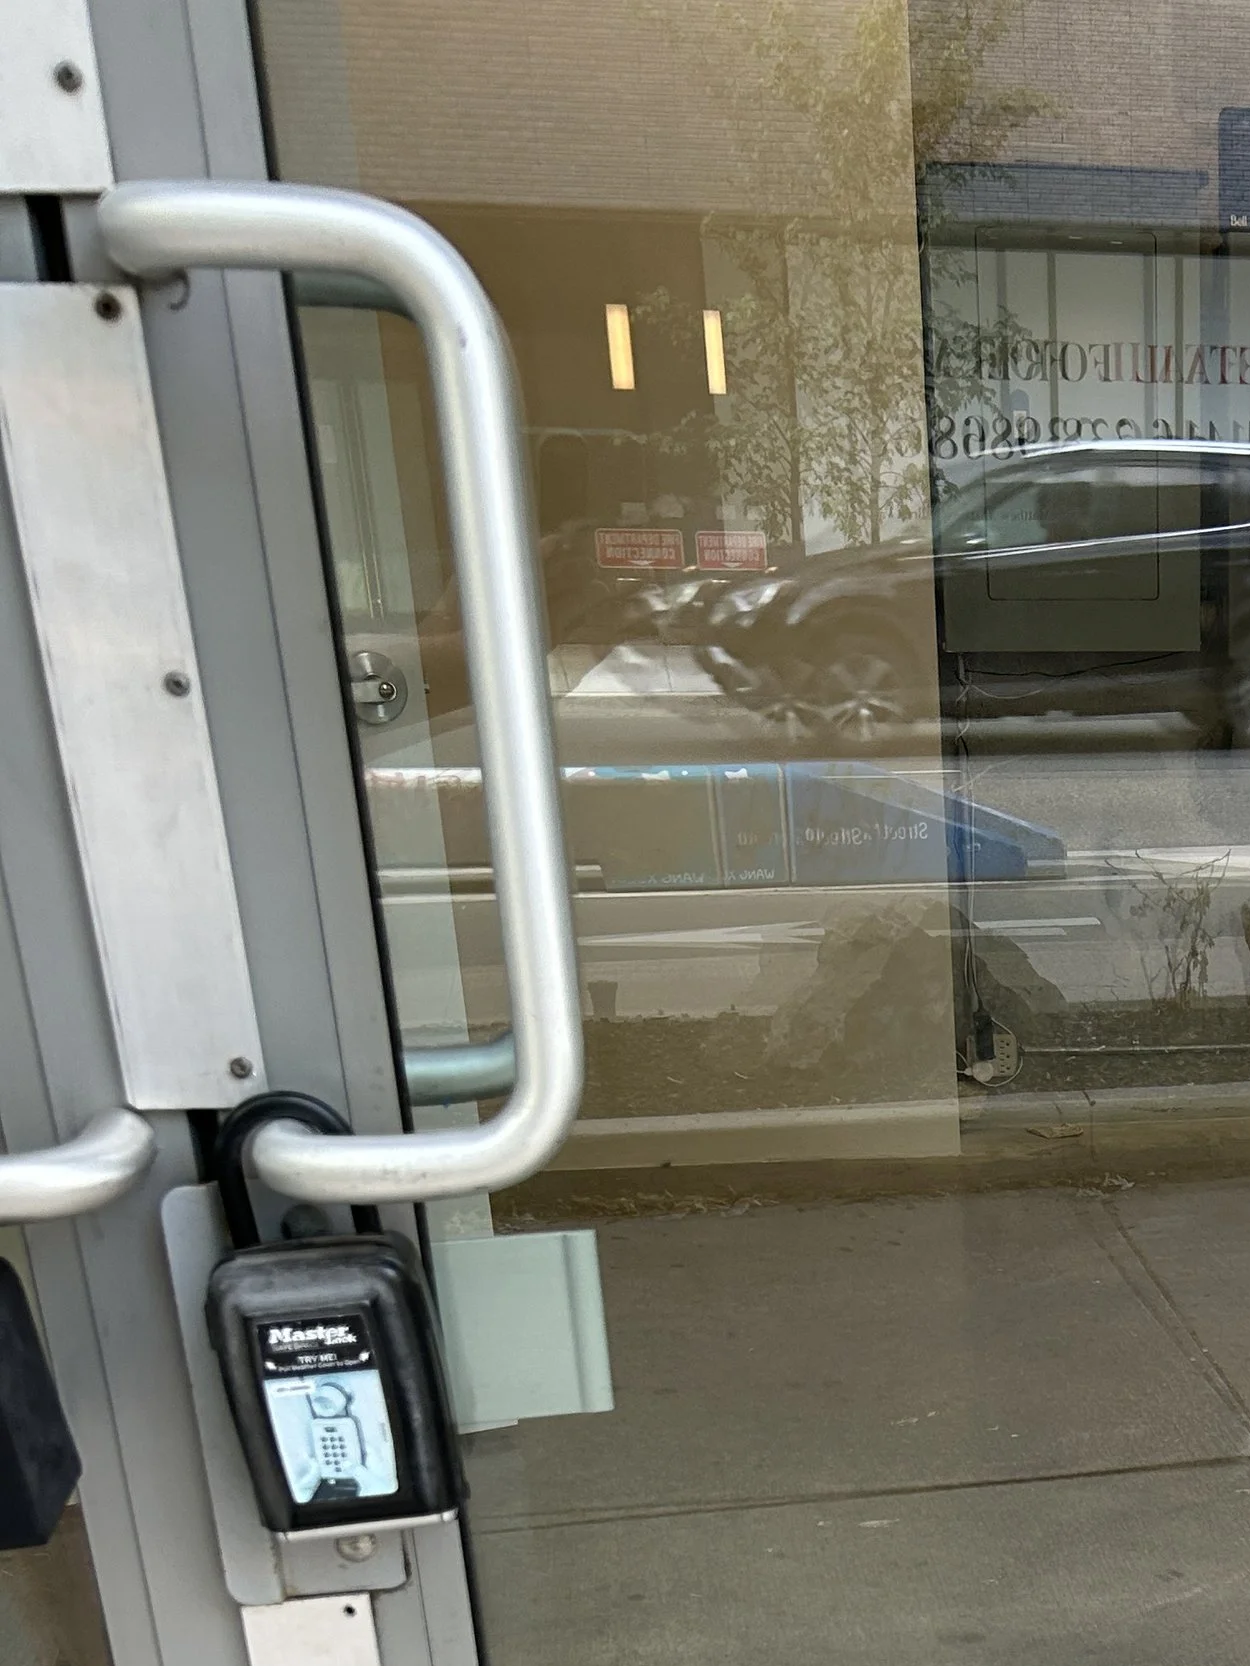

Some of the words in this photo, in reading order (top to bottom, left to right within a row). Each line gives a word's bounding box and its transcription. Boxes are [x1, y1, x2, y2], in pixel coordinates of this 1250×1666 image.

[1229, 213, 1248, 227] Bell
[268, 1325, 350, 1345] Master
[324, 1333, 358, 1346] Lock
[297, 1355, 318, 1364] TRY
